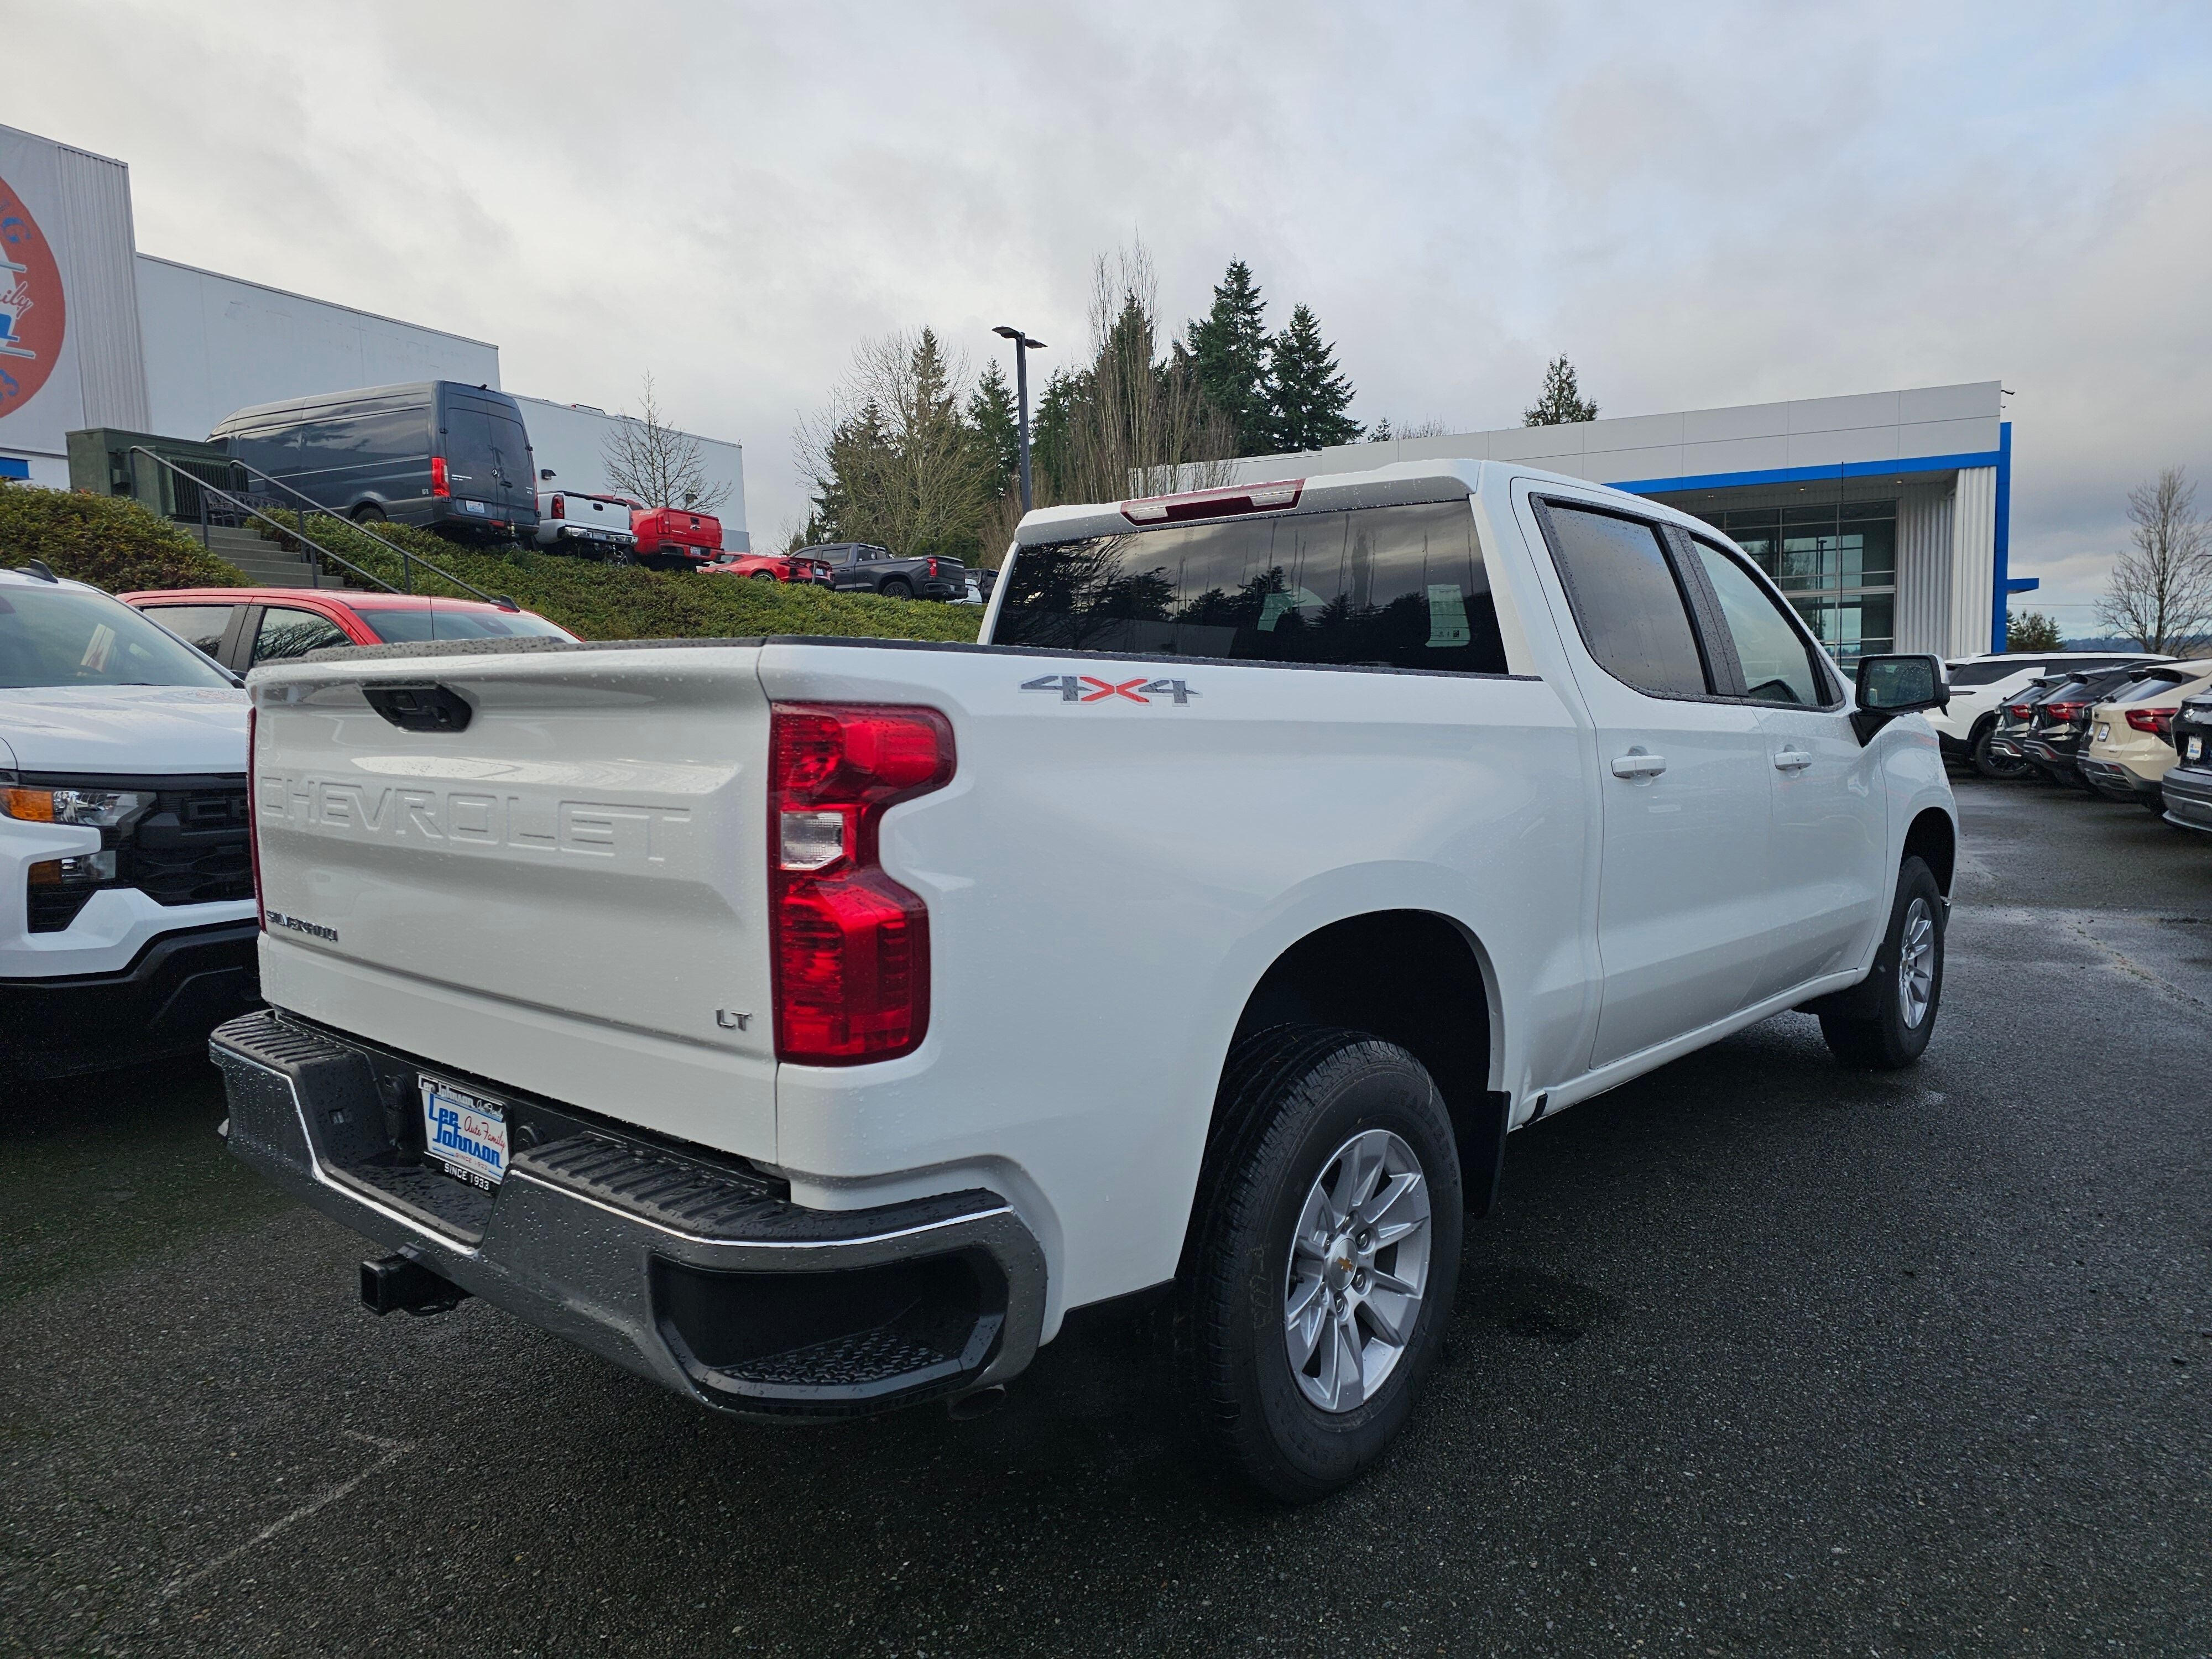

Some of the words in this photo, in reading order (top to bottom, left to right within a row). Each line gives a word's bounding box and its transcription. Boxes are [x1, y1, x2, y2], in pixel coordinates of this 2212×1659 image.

[260, 776, 691, 861] CHEVROLET
[716, 1009, 753, 1031] LT
[429, 1093, 460, 1127] Lee
[432, 1121, 503, 1169] Johnson
[464, 1116, 482, 1137] Auto
[481, 1122, 506, 1154] Family
[444, 1164, 467, 1181] SINCE
[470, 1175, 490, 1191] 1933
